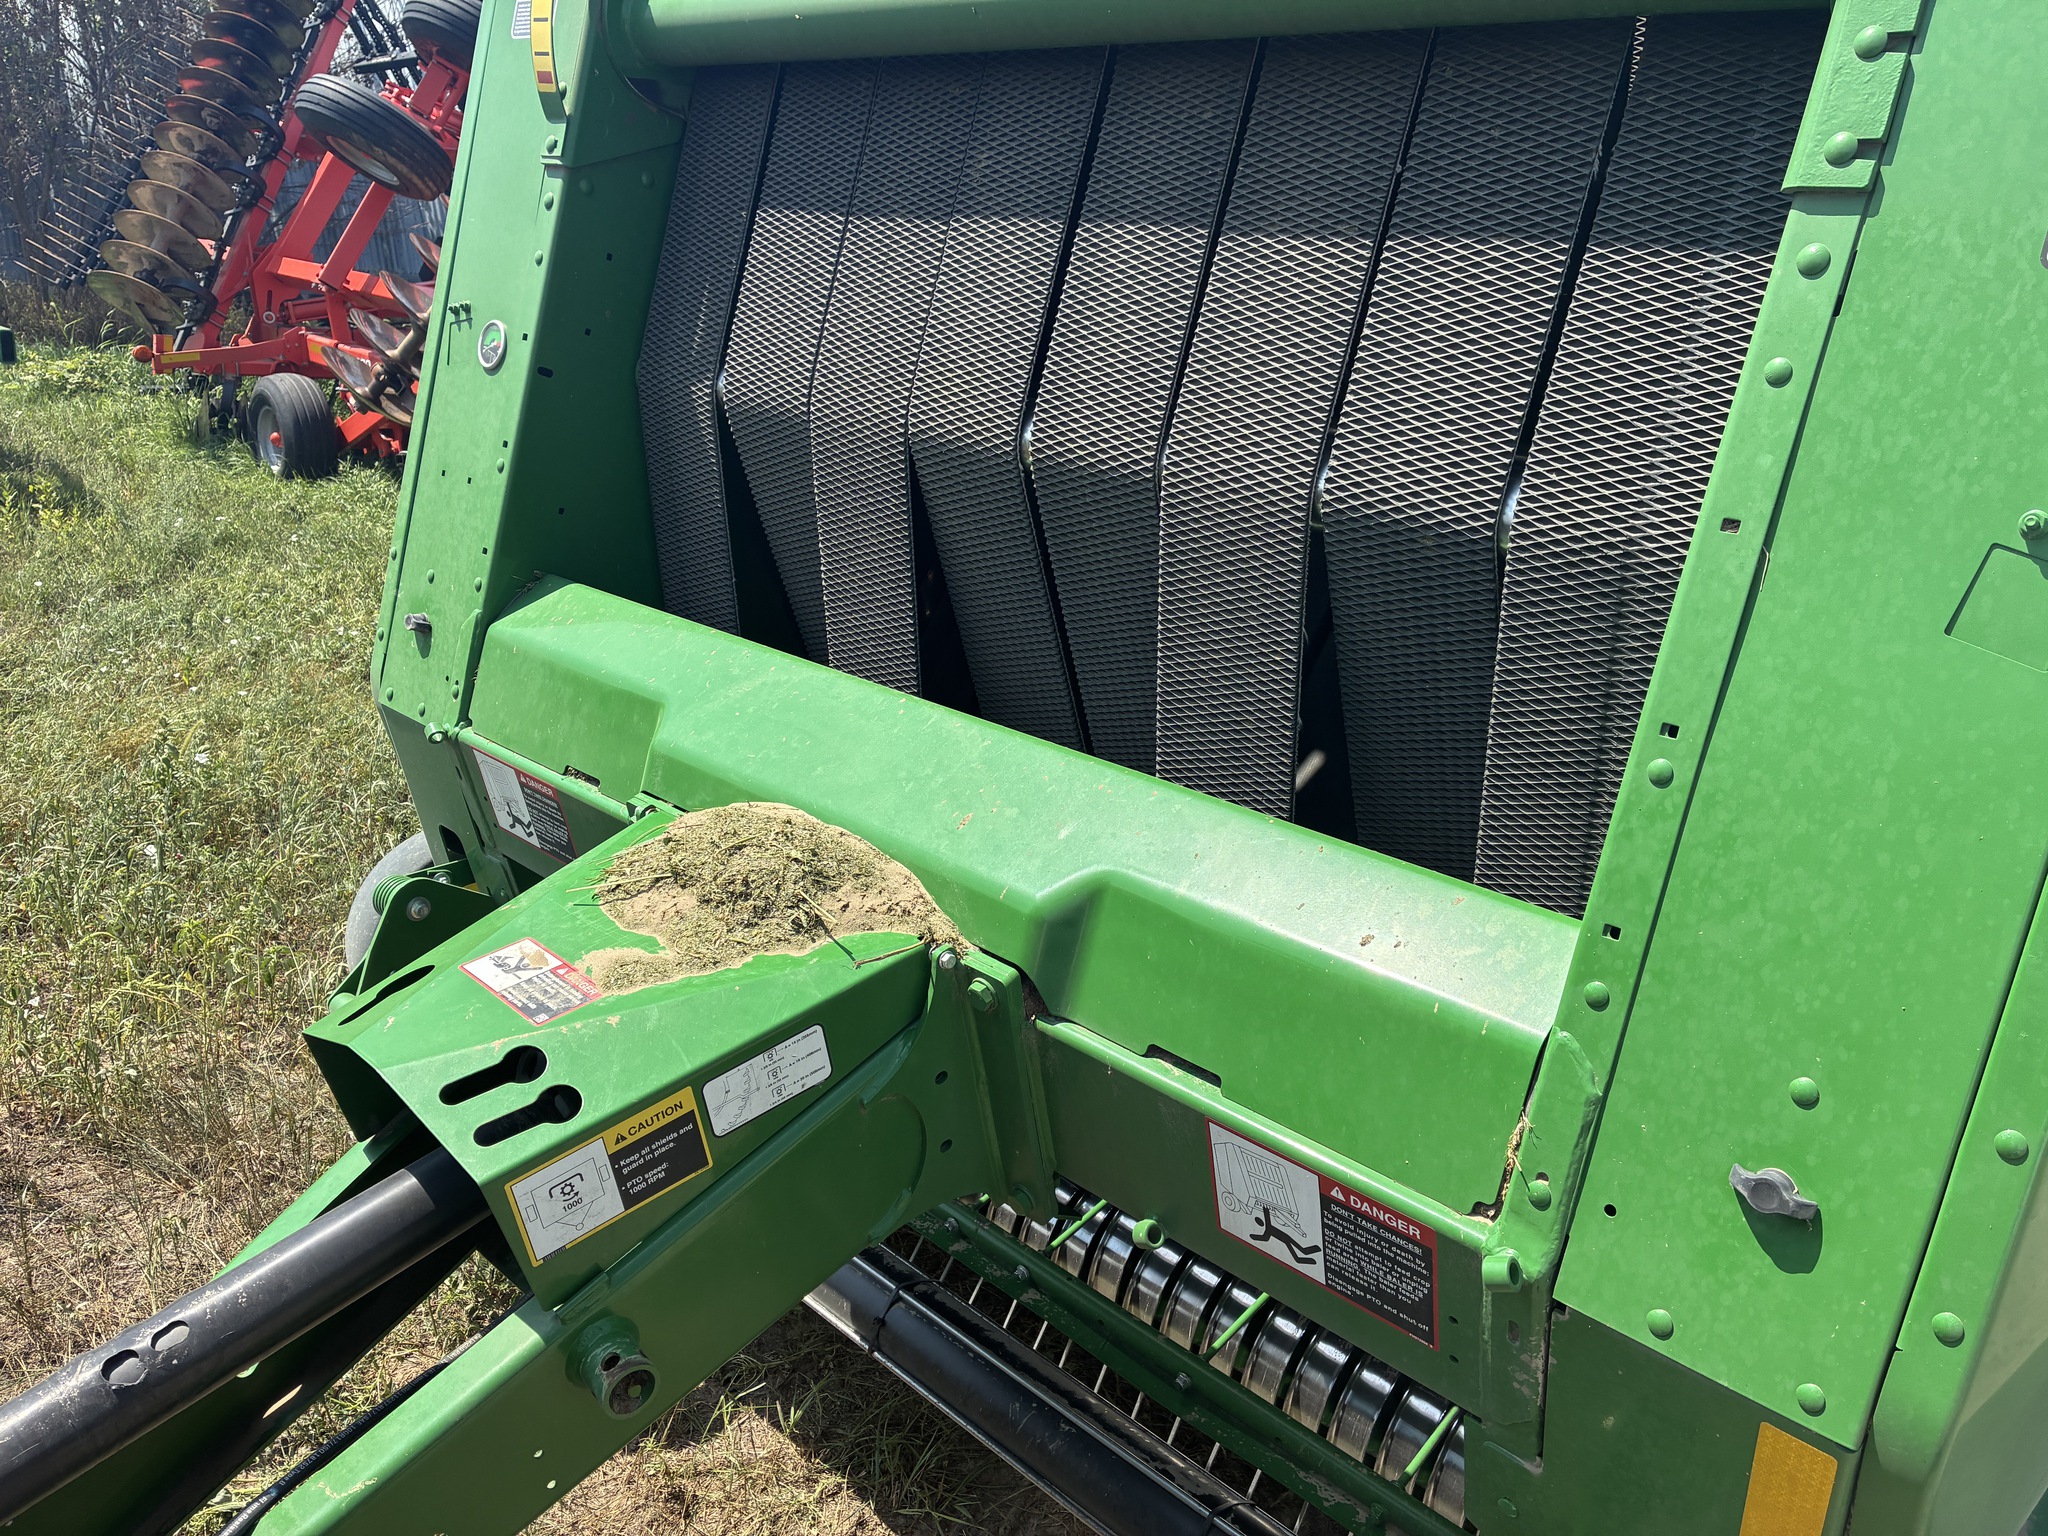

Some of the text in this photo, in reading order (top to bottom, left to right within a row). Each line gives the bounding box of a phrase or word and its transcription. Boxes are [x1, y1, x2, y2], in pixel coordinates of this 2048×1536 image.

[628, 1101, 683, 1135] CAUTION
[620, 1123, 693, 1166] Keep all shields and
[622, 1157, 644, 1174] guard
[654, 1142, 676, 1157] place.
[626, 1162, 668, 1188] PTO speed:
[629, 1171, 665, 1194] 1000 RPM
[563, 1197, 582, 1212] 1000
[1350, 1196, 1420, 1238] DANGER
[1323, 1210, 1332, 1218] To
[1334, 1217, 1354, 1230] avoid
[1356, 1228, 1378, 1243] injury
[1391, 1247, 1413, 1260] death
[1415, 1258, 1425, 1267] by
[1324, 1217, 1342, 1231] being
[1344, 1229, 1365, 1242] pulled
[1367, 1240, 1381, 1250] into
[1383, 1248, 1394, 1257] the
[1331, 1204, 1421, 1255] DON'T TAKE CHANCES!
[1324, 1228, 1335, 1238] DO
[1337, 1235, 1351, 1247] NOT
[1354, 1245, 1381, 1262] attempt
[1394, 1265, 1410, 1277] feed
[1413, 1276, 1430, 1287] crop
[1325, 1241, 1423, 1298] feed area WHILE BALER IS
[1326, 1262, 1339, 1271] can
[1341, 1270, 1368, 1286] release
[1334, 1240, 1353, 1253] twine
[1355, 1251, 1369, 1261] into
[1371, 1259, 1389, 1272] baler
[1402, 1277, 1427, 1293] unplug
[1326, 1255, 1411, 1304] material faster than you
[1328, 1280, 1353, 1296] engine.
[1364, 1268, 1377, 1278] The
[1379, 1276, 1396, 1289] baler
[1399, 1287, 1418, 1301] feeds
[1327, 1273, 1428, 1331] Disengage PTO and shut off
